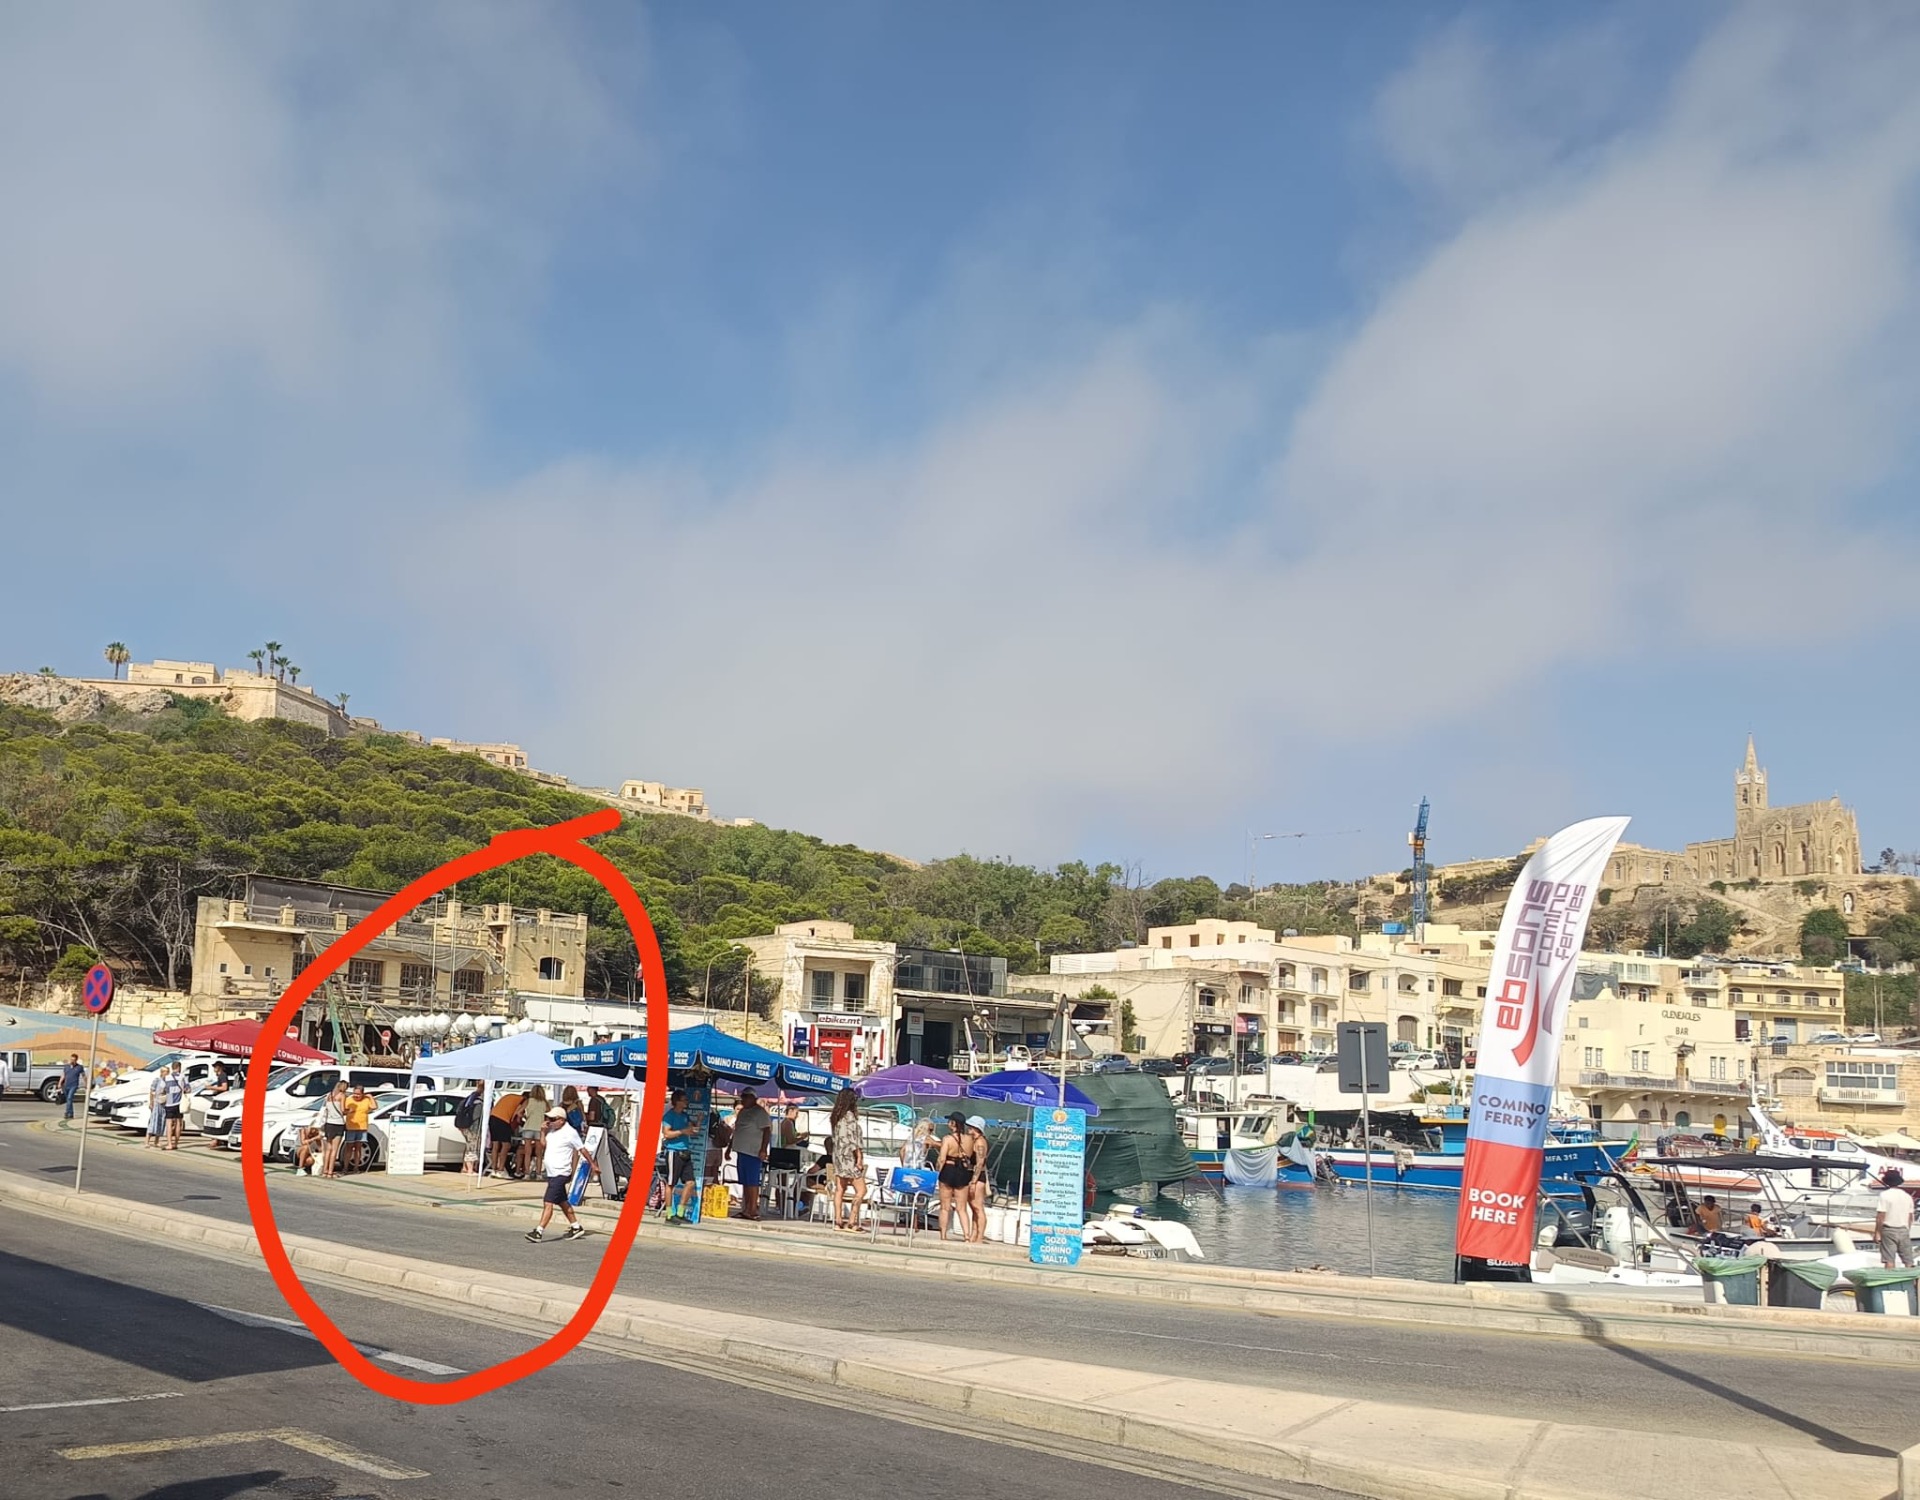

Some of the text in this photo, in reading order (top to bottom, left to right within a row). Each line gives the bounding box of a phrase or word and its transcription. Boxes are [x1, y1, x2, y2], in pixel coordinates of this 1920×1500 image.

[1536, 883, 1570, 967] comino
[1555, 884, 1587, 960] ferries
[819, 1015, 861, 1025] ebike.mt
[1675, 1027, 1689, 1036] BAR
[214, 1041, 240, 1052] COMINO
[278, 1050, 302, 1062] COMINO
[561, 1053, 597, 1062] COMINO FERRY
[629, 1053, 647, 1061] COMIN
[707, 1055, 752, 1072] COMINO FERRY
[755, 1062, 771, 1070] BOOK
[755, 1069, 770, 1077] HERE
[789, 1071, 828, 1085] COMINO FERRY
[831, 1077, 844, 1085] BOOK
[1478, 1094, 1546, 1116] COMINO
[1485, 1111, 1538, 1129] FERRY
[1046, 1125, 1073, 1133] COMINO
[1054, 1133, 1083, 1141] LAGOON
[1563, 1153, 1578, 1161] 312
[1469, 1188, 1526, 1209] BOOK
[1471, 1206, 1518, 1225] HERE
[1045, 1236, 1067, 1244] GOZO
[1041, 1245, 1072, 1254] COMINO
[1042, 1254, 1068, 1264] MALTA
